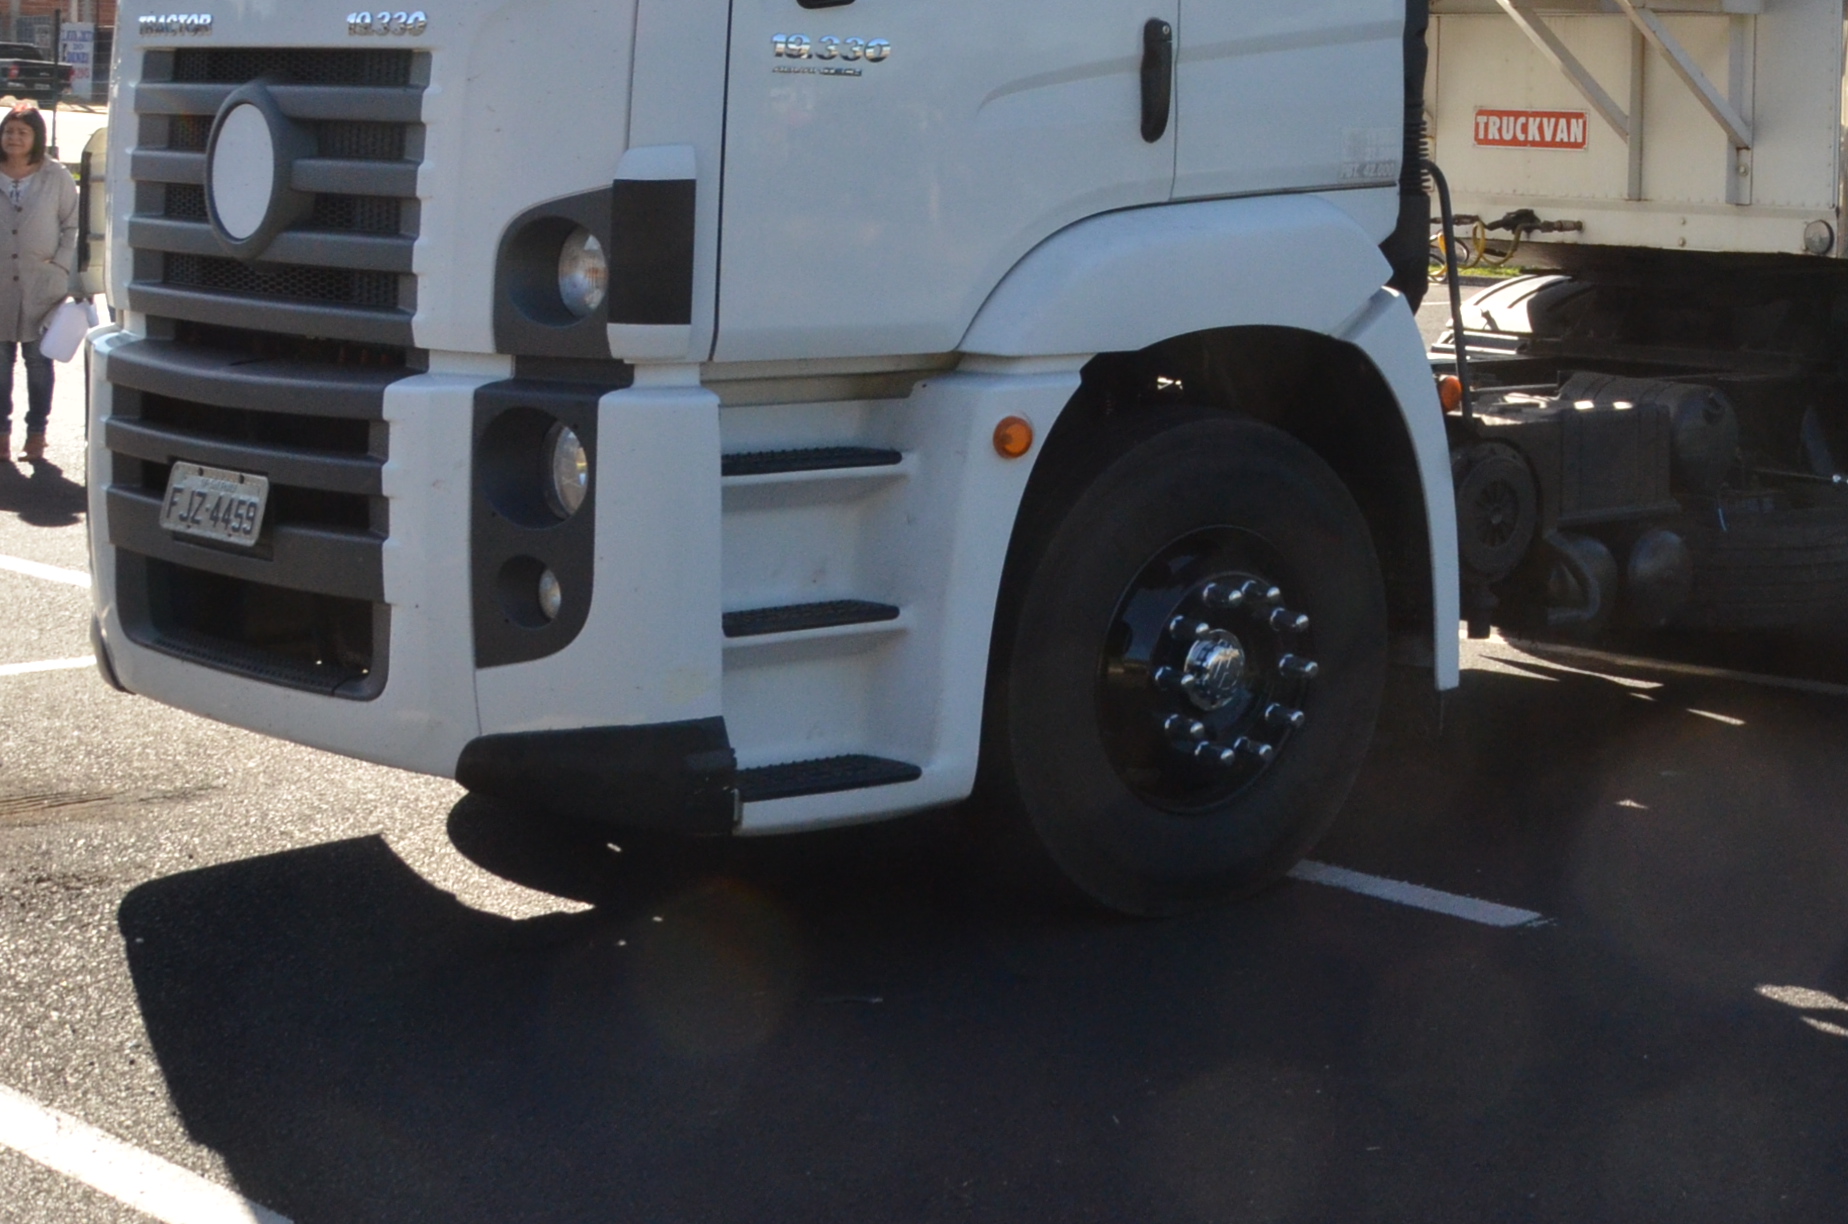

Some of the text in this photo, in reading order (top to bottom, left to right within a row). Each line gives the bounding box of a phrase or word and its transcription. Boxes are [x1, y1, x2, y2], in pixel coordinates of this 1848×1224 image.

[138, 13, 213, 37] TRACTOR
[346, 10, 427, 36] 19.330
[770, 33, 892, 63] 19.330
[1476, 115, 1583, 143] TRUCKVAN
